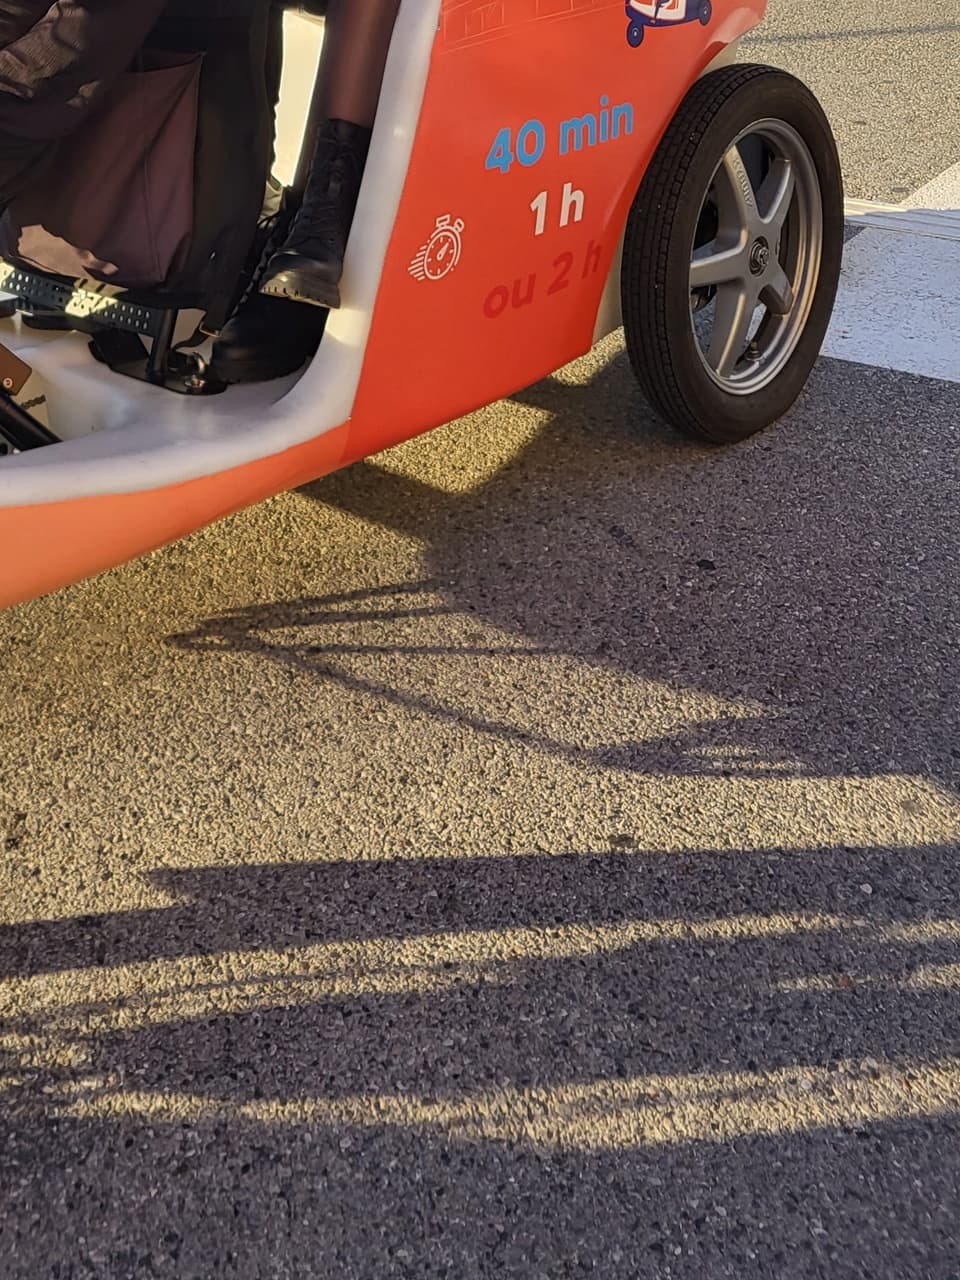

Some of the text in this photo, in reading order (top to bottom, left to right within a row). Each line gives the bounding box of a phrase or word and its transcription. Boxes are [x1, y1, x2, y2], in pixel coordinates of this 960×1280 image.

[484, 95, 634, 174] 40 min
[529, 181, 586, 237] 1 h
[482, 239, 603, 320] ou 2 h
